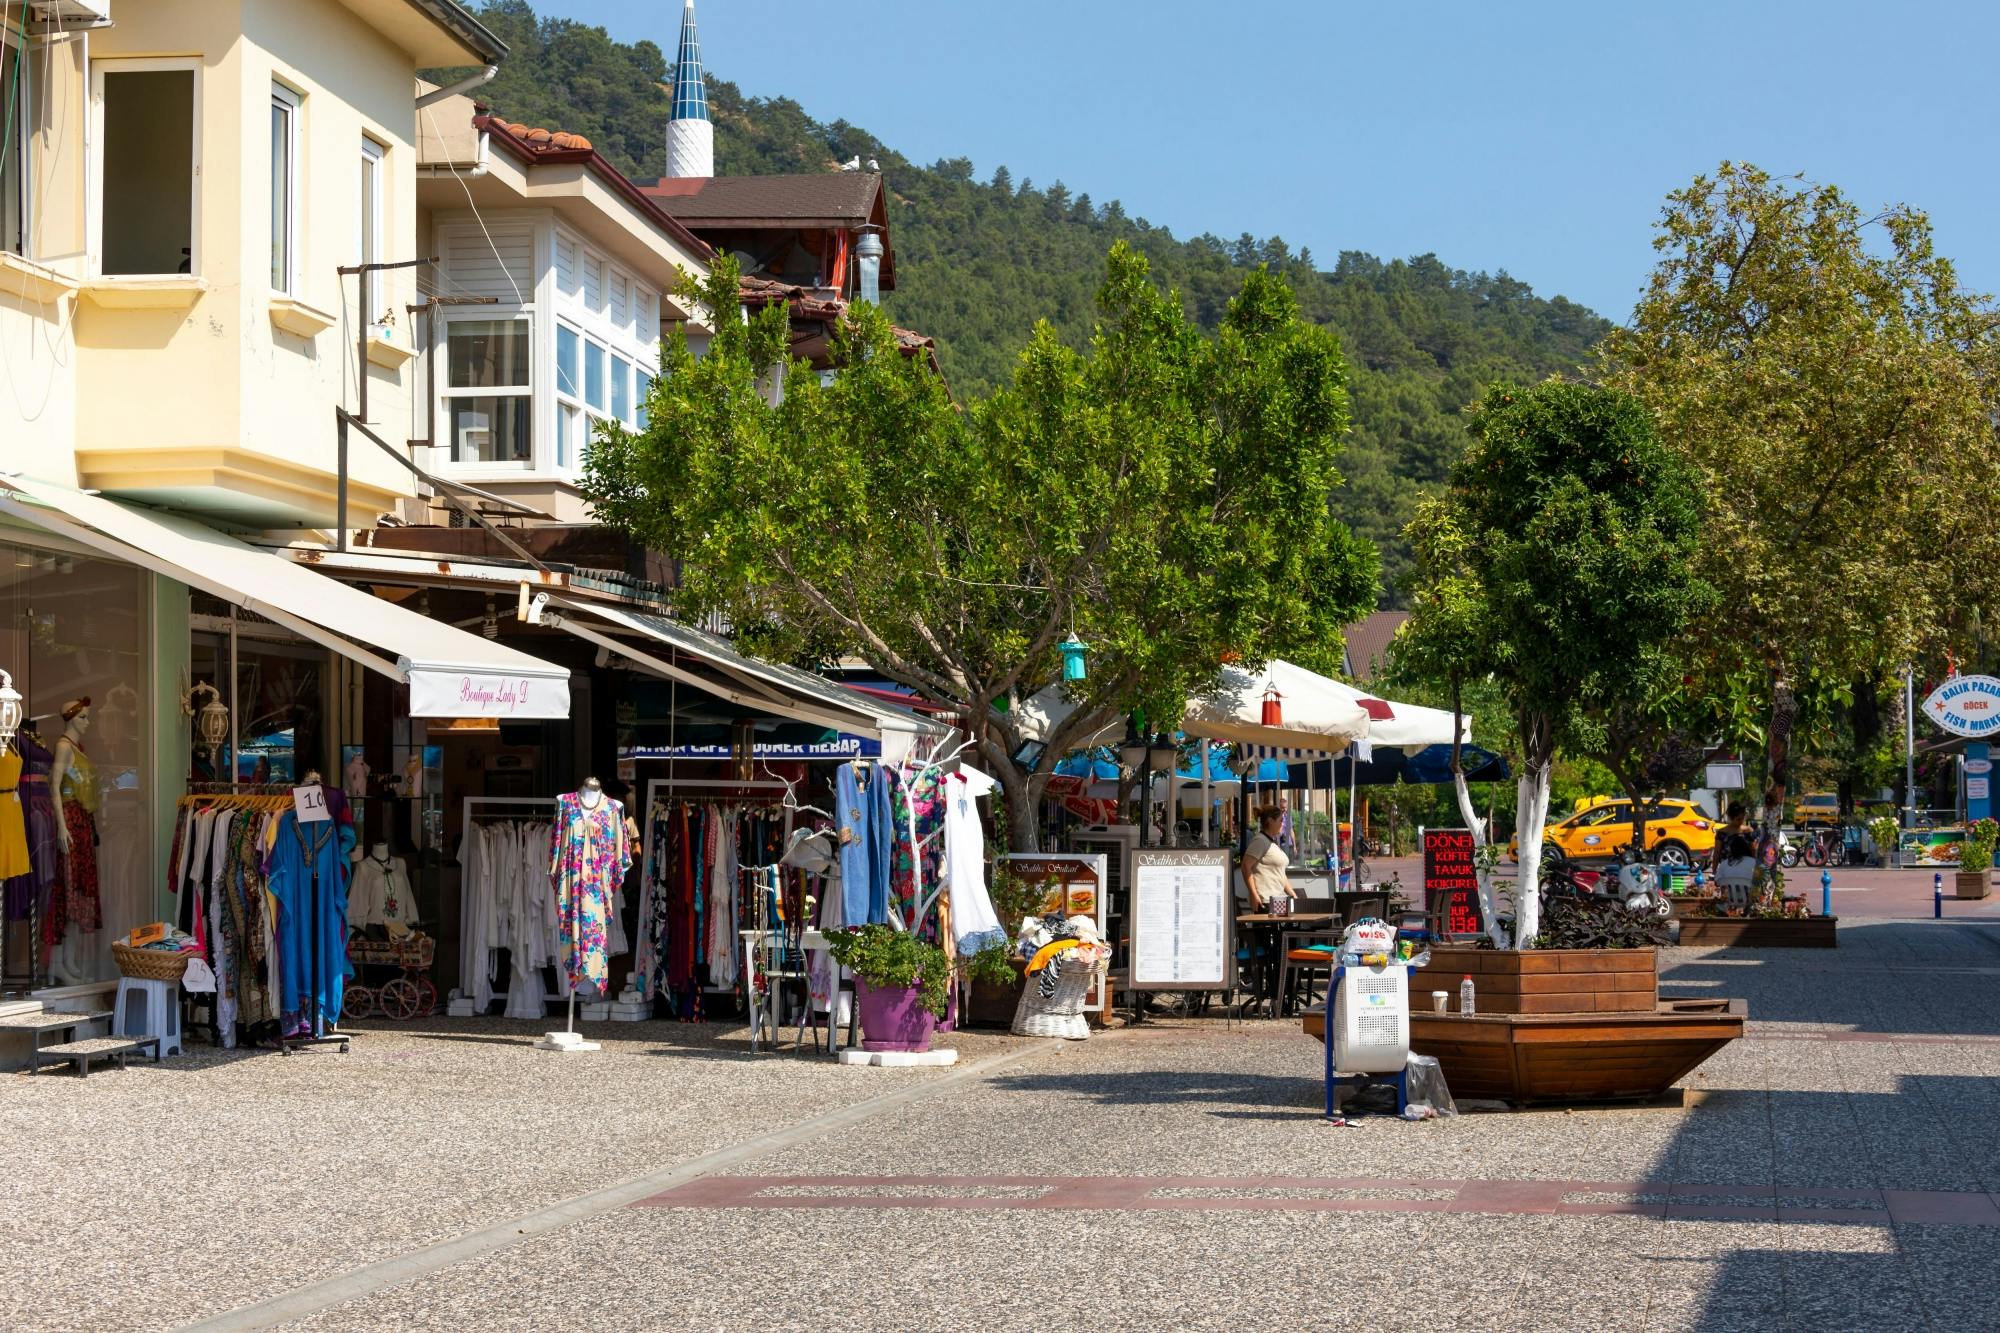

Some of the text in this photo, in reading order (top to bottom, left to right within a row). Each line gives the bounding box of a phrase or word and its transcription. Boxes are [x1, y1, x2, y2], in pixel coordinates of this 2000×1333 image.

[460, 677, 494, 711] Boutique
[496, 679, 516, 712] Lady
[1941, 682, 1970, 701] BALIK
[1963, 700, 1989, 710] GÖCEK
[1944, 711, 1967, 728] FISH
[1433, 865, 1473, 875] TAVUK
